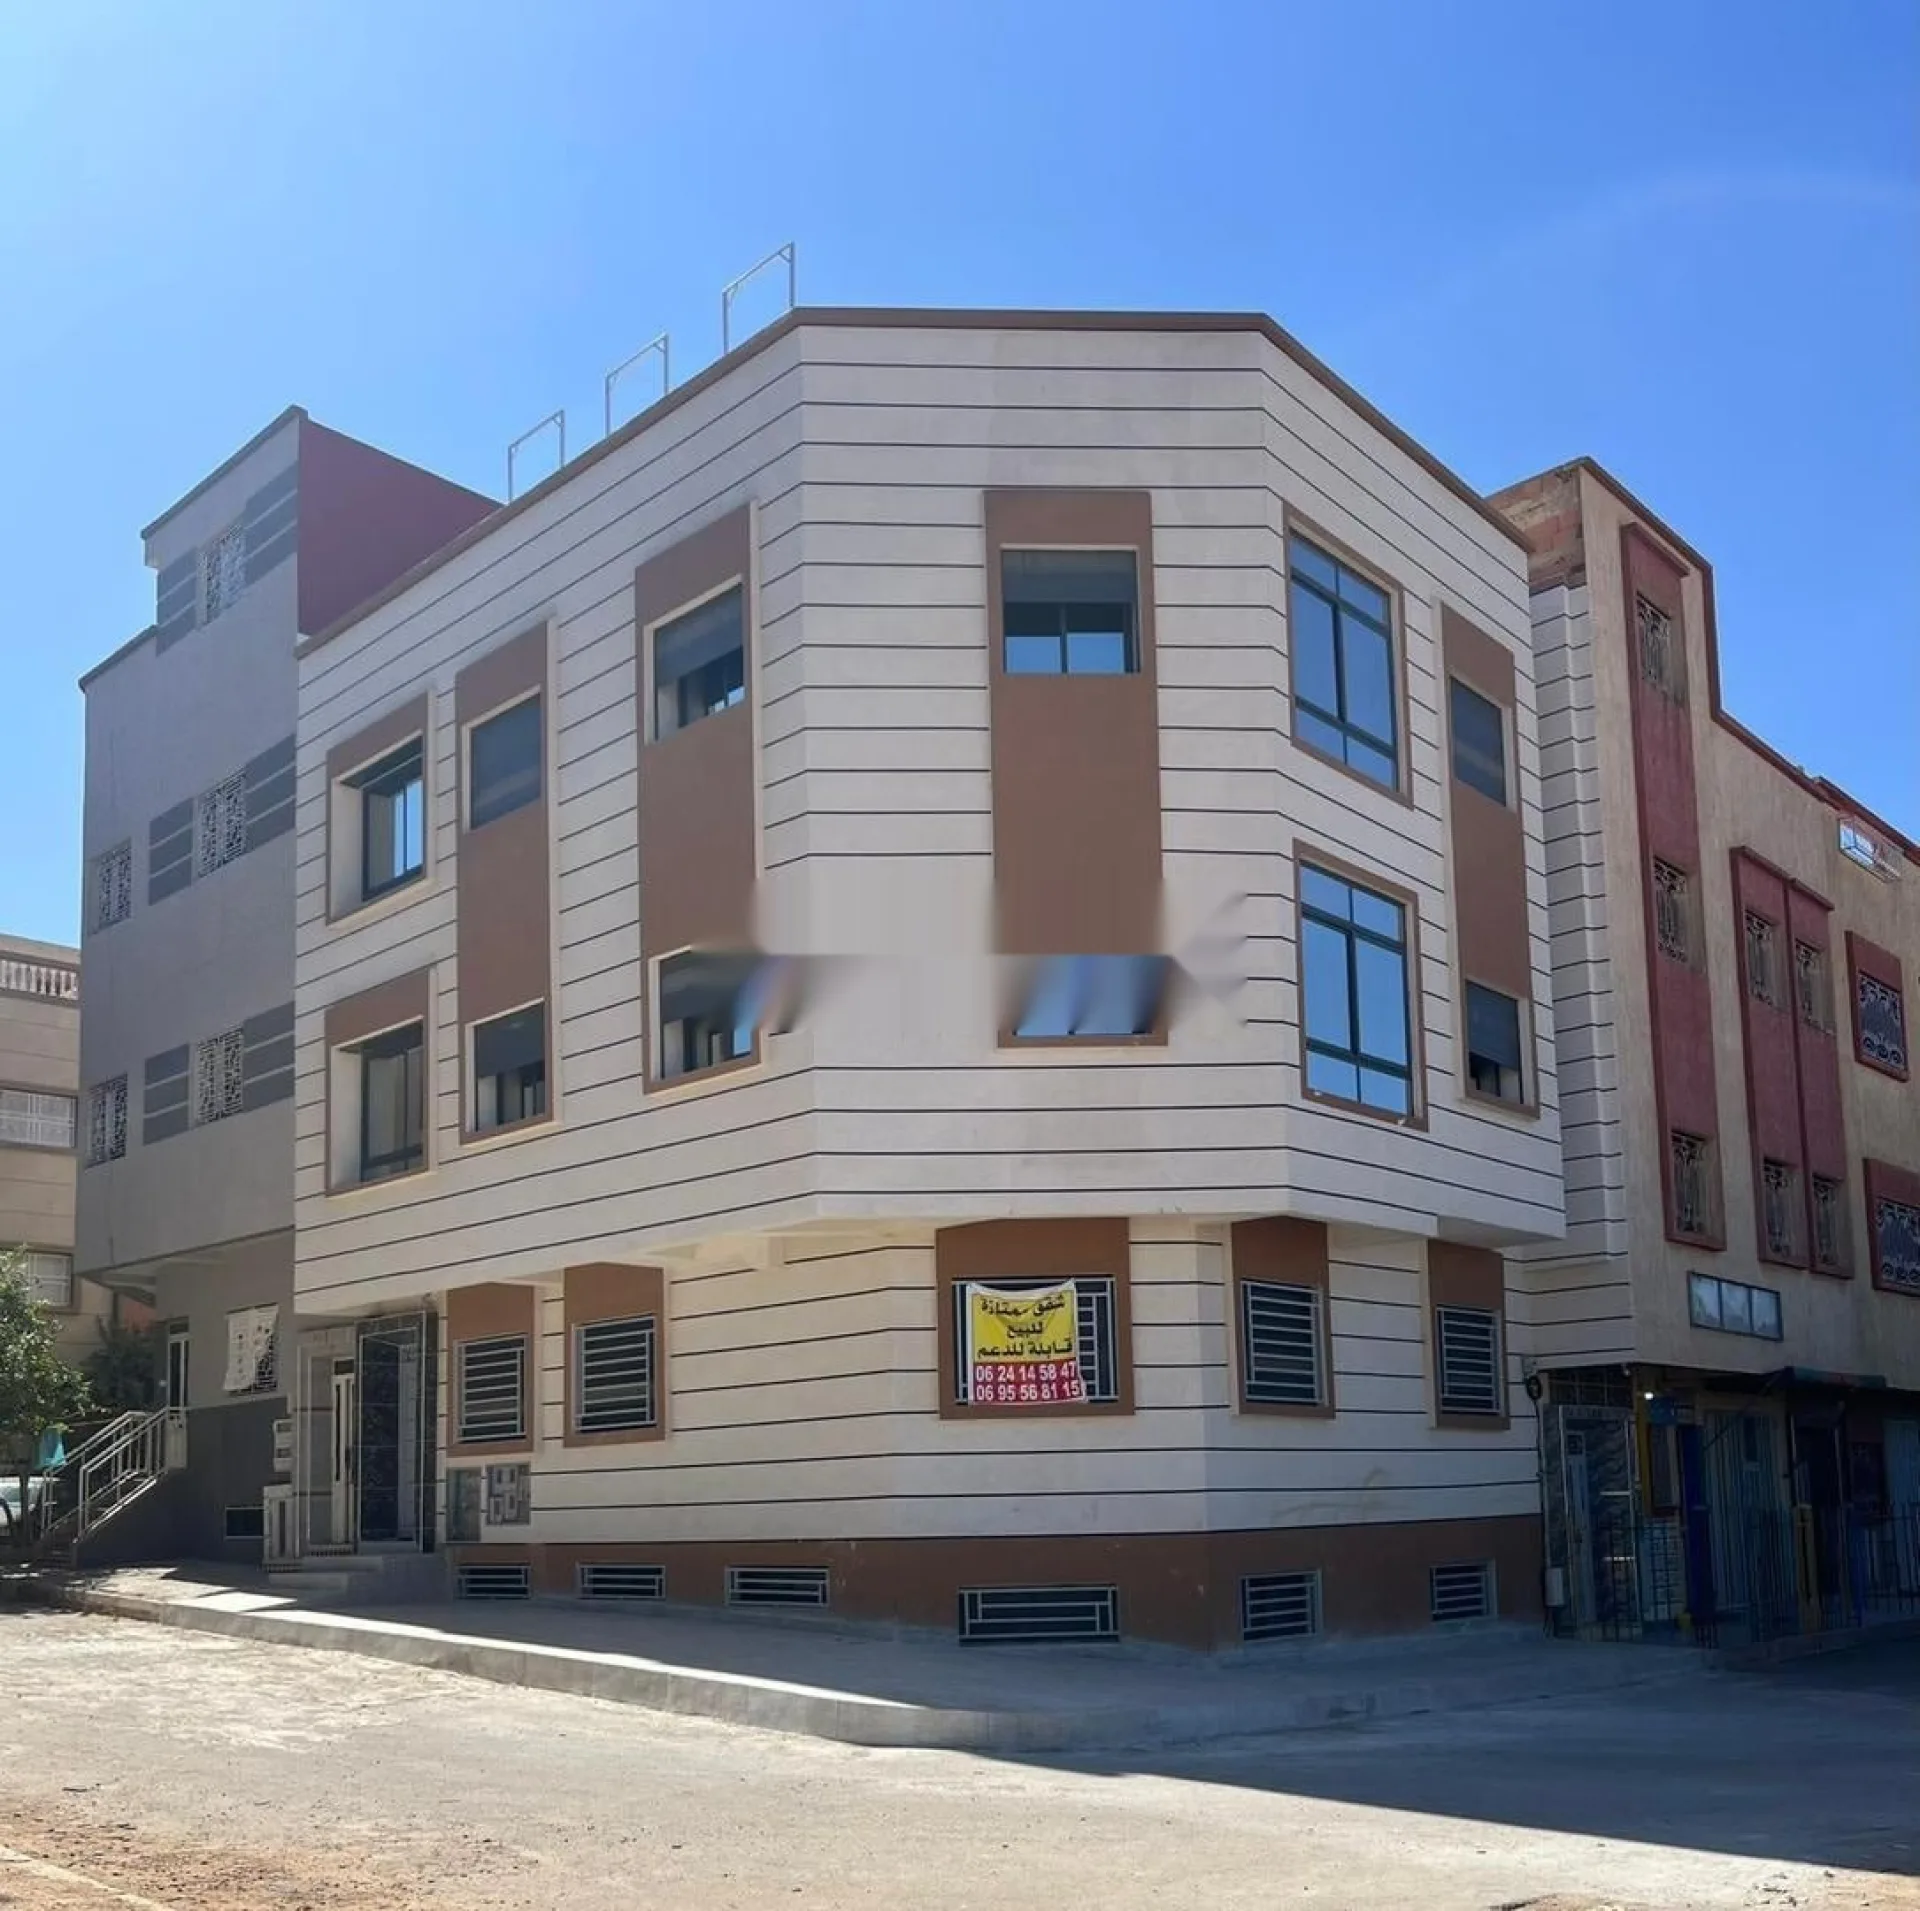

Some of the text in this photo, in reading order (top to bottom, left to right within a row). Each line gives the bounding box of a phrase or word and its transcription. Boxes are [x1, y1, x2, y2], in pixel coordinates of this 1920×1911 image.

[1033, 1294, 1065, 1316] شقق
[1007, 1321, 1043, 1338] للبيع
[977, 1337, 1073, 1359] قابلة للدعم
[976, 1361, 1077, 1382] 06 24 14 58 47
[976, 1380, 1080, 1401] 06 95 56 81 15
